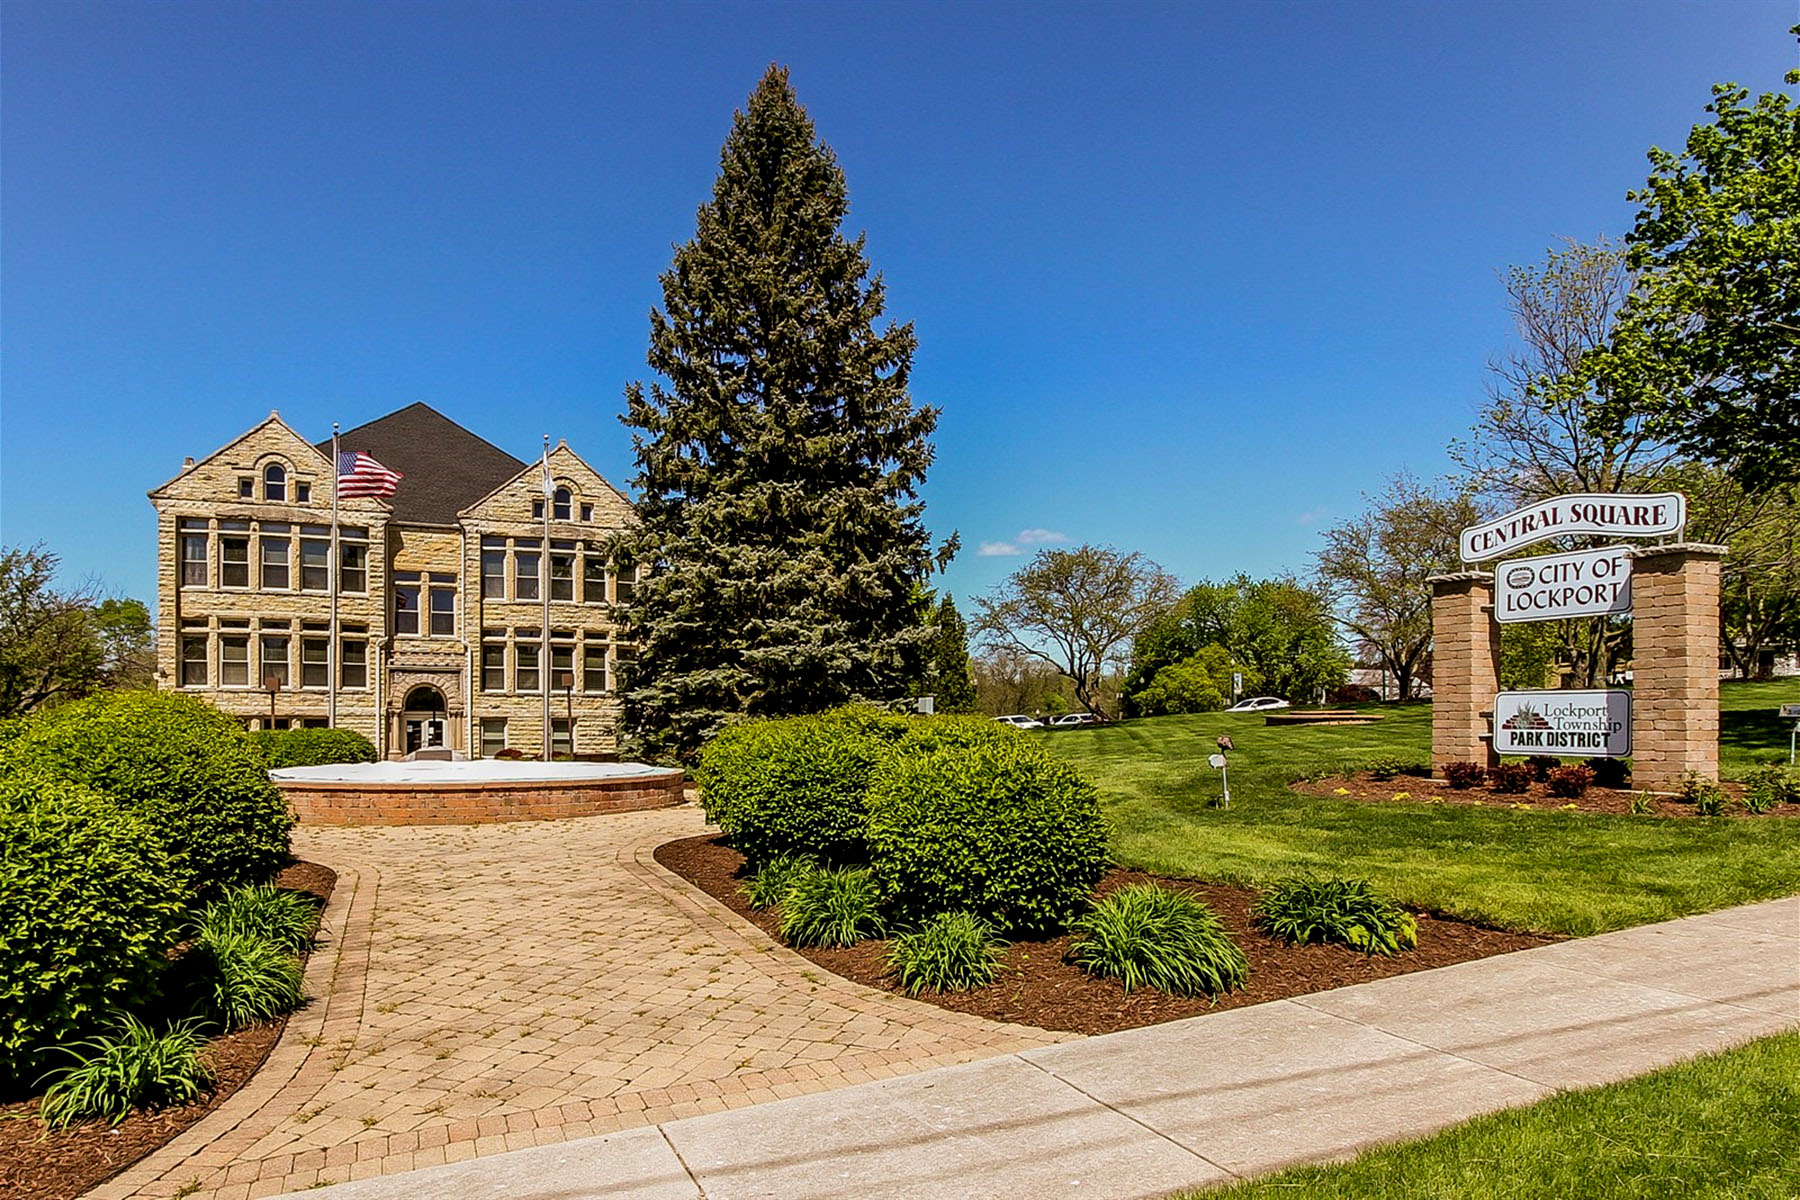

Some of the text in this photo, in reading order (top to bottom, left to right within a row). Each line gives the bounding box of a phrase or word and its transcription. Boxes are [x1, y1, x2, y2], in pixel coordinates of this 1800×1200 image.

[1470, 503, 1667, 553] CENTRAL SQUARE
[1539, 561, 1585, 585] CITY
[1592, 556, 1622, 578] OF
[1507, 582, 1622, 612] LOCKPORT
[1544, 703, 1607, 720] Lockport
[1553, 717, 1622, 733] Township
[1510, 732, 1611, 747] PARK DISTRICT
